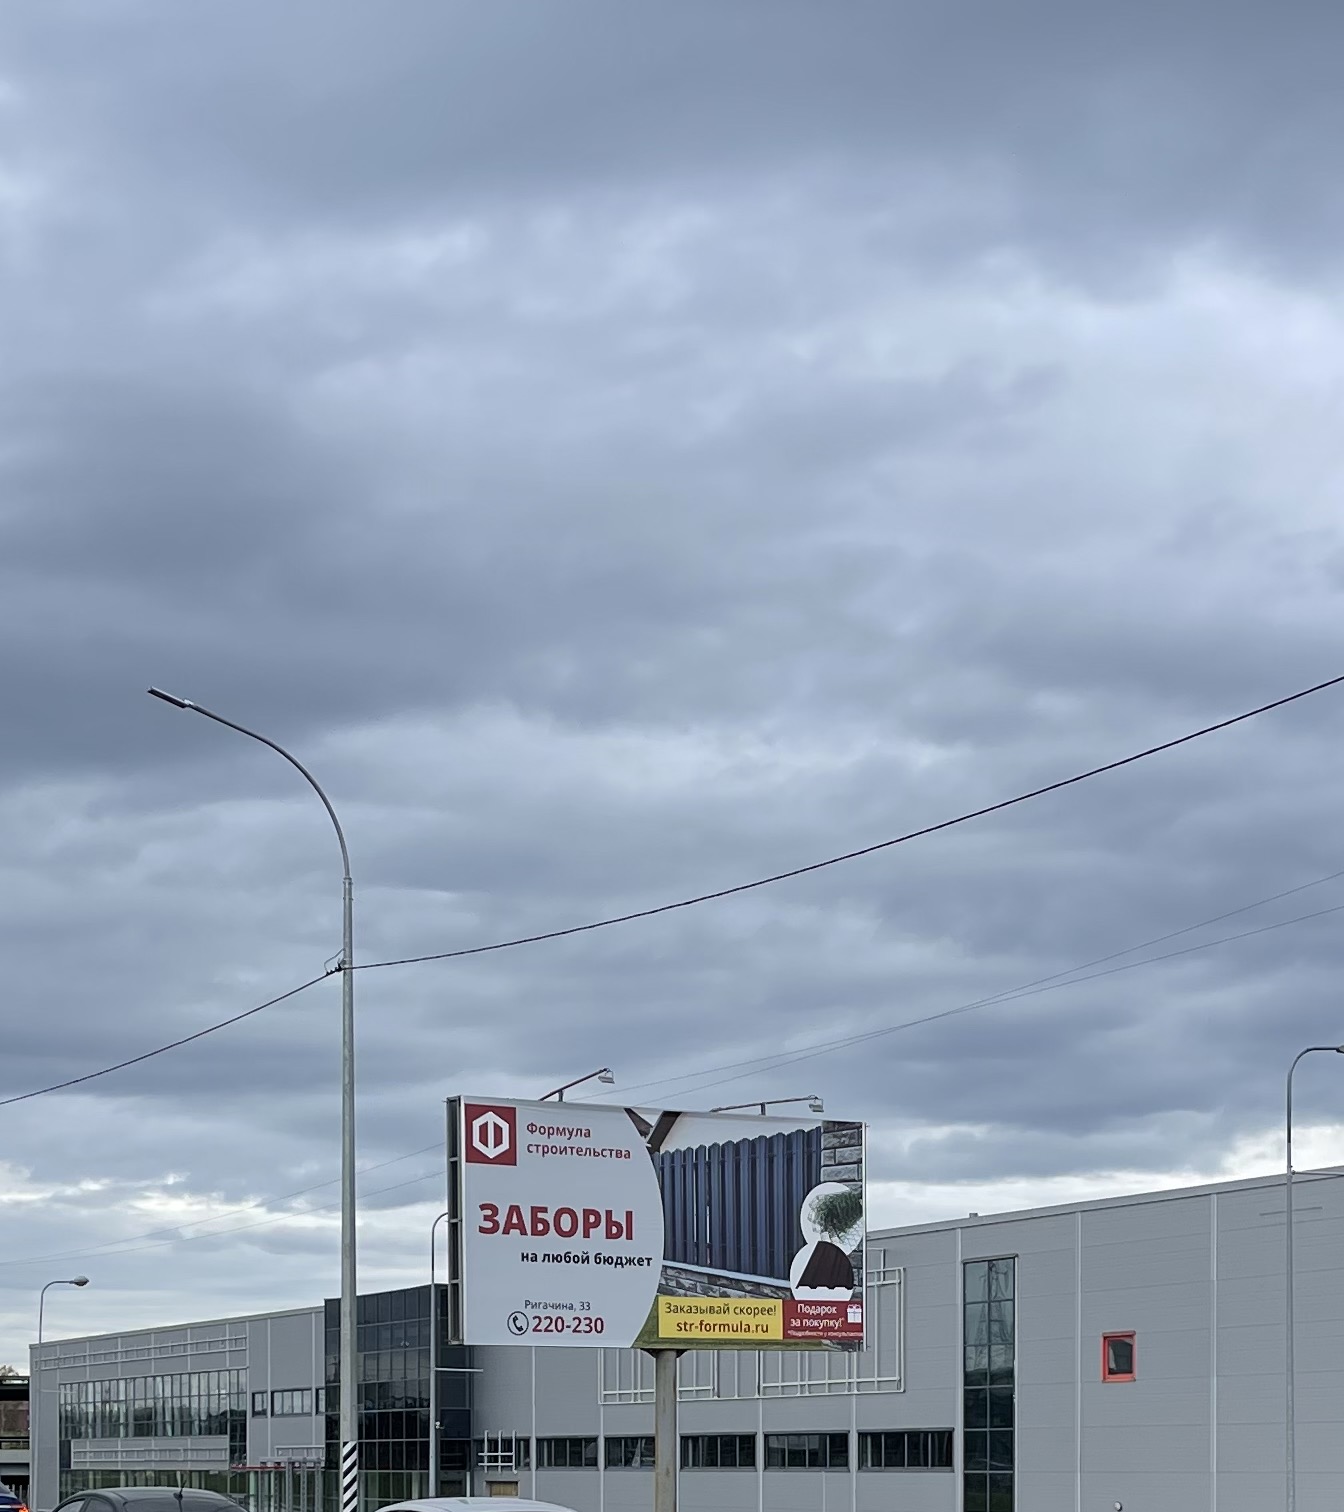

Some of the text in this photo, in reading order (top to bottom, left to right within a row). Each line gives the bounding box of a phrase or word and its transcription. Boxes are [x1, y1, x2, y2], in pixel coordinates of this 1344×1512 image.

[526, 1122, 591, 1139] Формула
[526, 1143, 631, 1160] строительства
[478, 1203, 634, 1241] ЗАБОРЫ
[521, 1251, 653, 1268] на любой бюджет
[524, 1300, 591, 1312] Ригачина, 33
[665, 1302, 777, 1318] Заказывай скорее!
[797, 1303, 838, 1316] Подарок
[532, 1315, 604, 1334] 220-230
[676, 1319, 769, 1334] str-formula.ru
[790, 1318, 801, 1327] за
